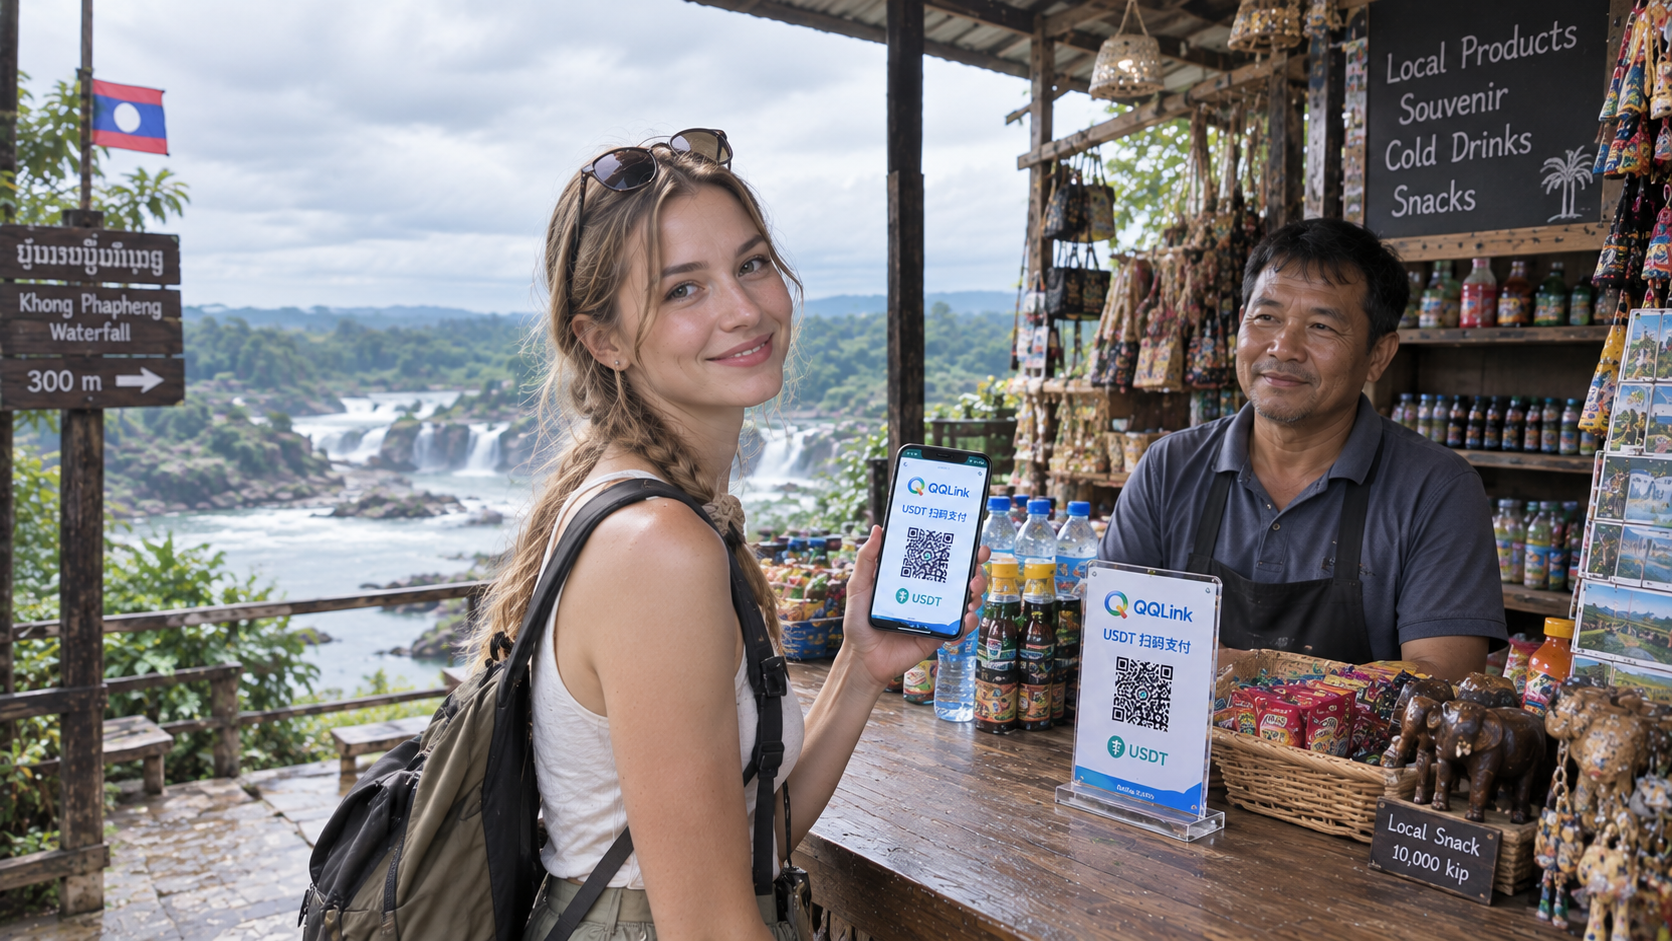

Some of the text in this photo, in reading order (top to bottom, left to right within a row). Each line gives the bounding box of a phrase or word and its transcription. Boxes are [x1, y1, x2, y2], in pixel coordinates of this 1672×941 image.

[1386, 20, 1577, 84] Local Products
[1399, 82, 1508, 125] Souvenir
[1385, 123, 1532, 171] Cold Drinks
[1392, 180, 1476, 217] Snacks
[20, 293, 162, 320] Khong Phapheng
[50, 321, 131, 342] Waterfall
[27, 369, 102, 393] 300 m
[928, 482, 970, 499] QQLink
[902, 504, 968, 523] USDT 扫码支付
[912, 593, 943, 607] USDT
[1133, 599, 1193, 623] QQLink
[1103, 628, 1191, 655] USDT 扫码支付
[1129, 744, 1169, 766] USDT
[1388, 813, 1480, 857] Local Snack
[1392, 844, 1470, 885] 10,000 kip
